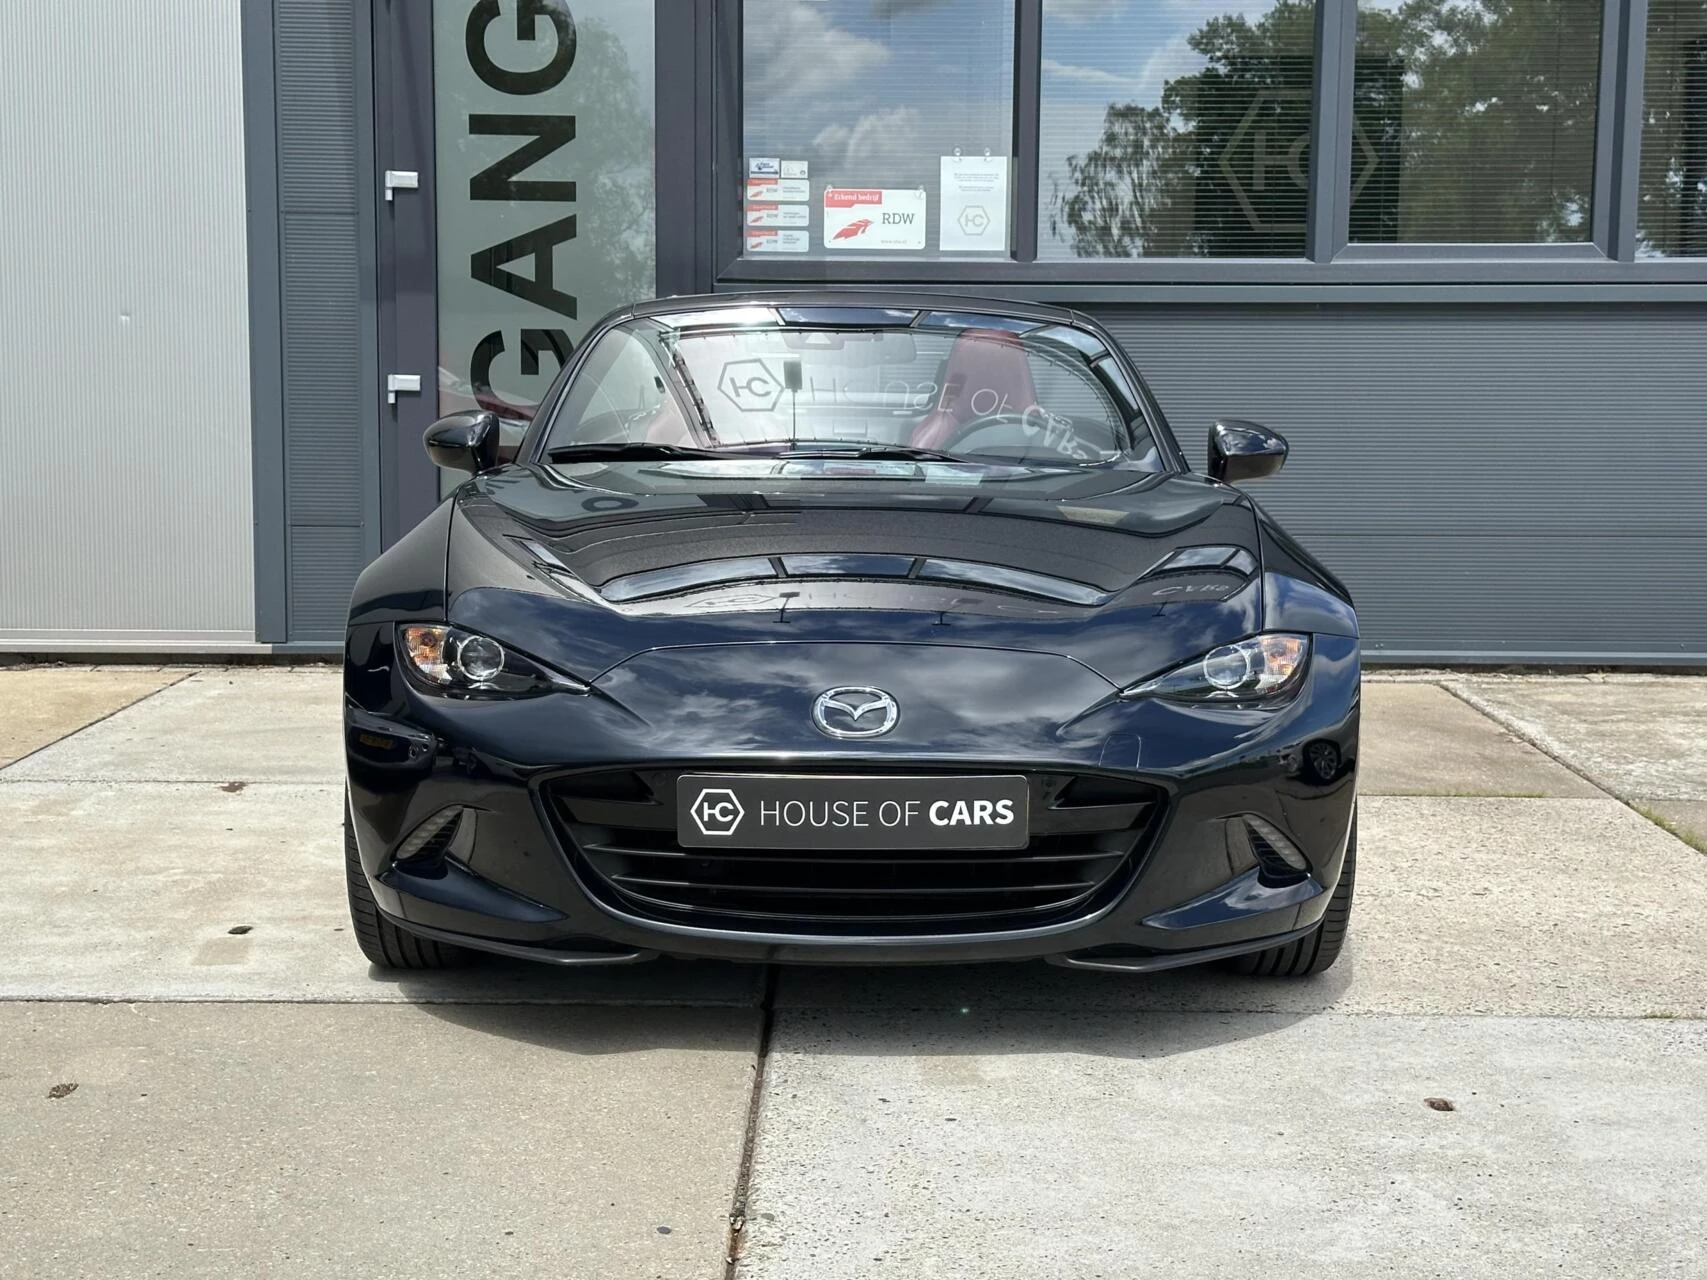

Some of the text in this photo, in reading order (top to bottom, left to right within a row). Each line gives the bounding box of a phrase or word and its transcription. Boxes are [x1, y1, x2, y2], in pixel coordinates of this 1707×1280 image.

[834, 193, 880, 202] Erkend bedrijf
[882, 212, 915, 225] RDW
[760, 801, 869, 827] HOUSE
[878, 800, 921, 826] OF
[929, 799, 1014, 826] CARS
